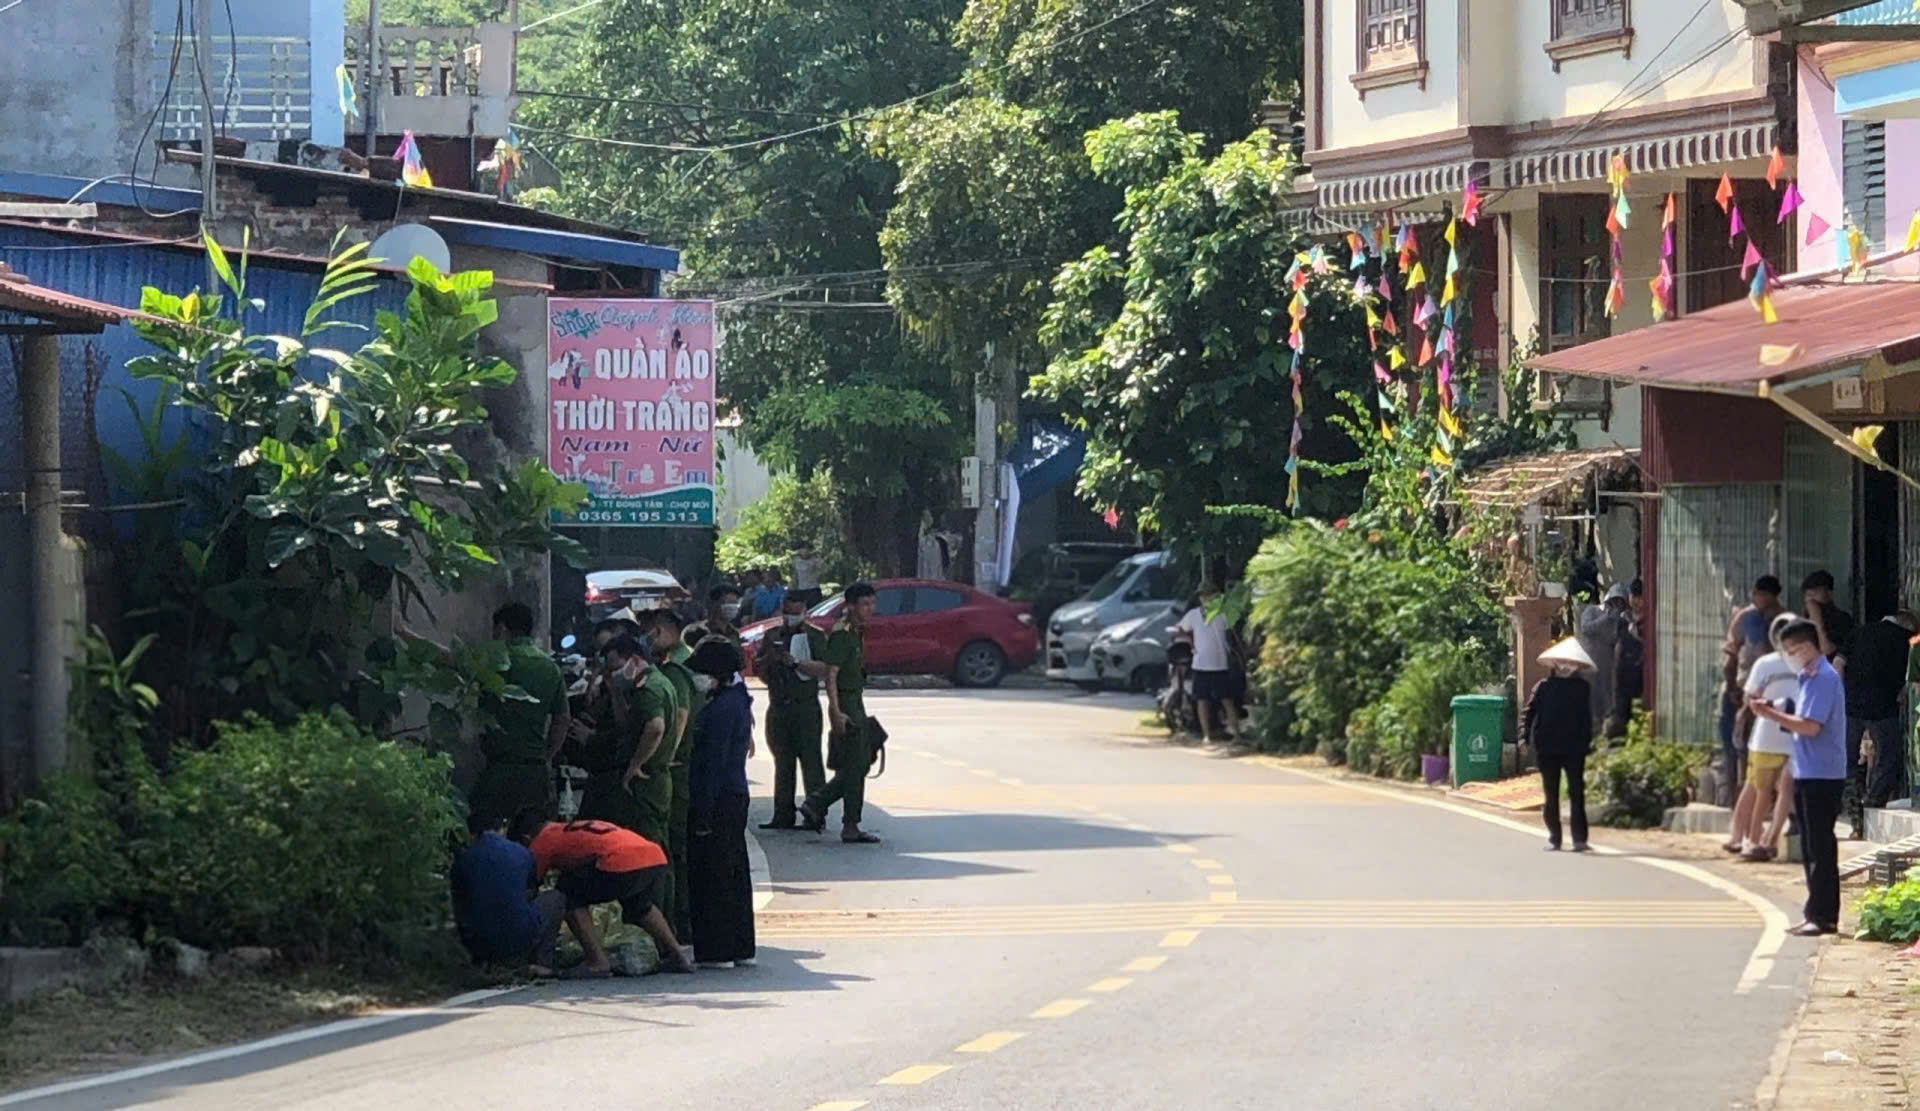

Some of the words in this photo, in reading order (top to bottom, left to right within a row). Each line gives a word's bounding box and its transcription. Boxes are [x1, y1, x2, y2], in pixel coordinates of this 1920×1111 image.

[594, 336, 668, 380] QUẦN
[674, 342, 710, 379] ÁO
[553, 394, 616, 432] THỜI
[560, 436, 630, 452] Nam
[664, 459, 708, 484] Em
[579, 510, 622, 522] 0365
[629, 510, 661, 522] 195
[666, 510, 699, 522] 313
